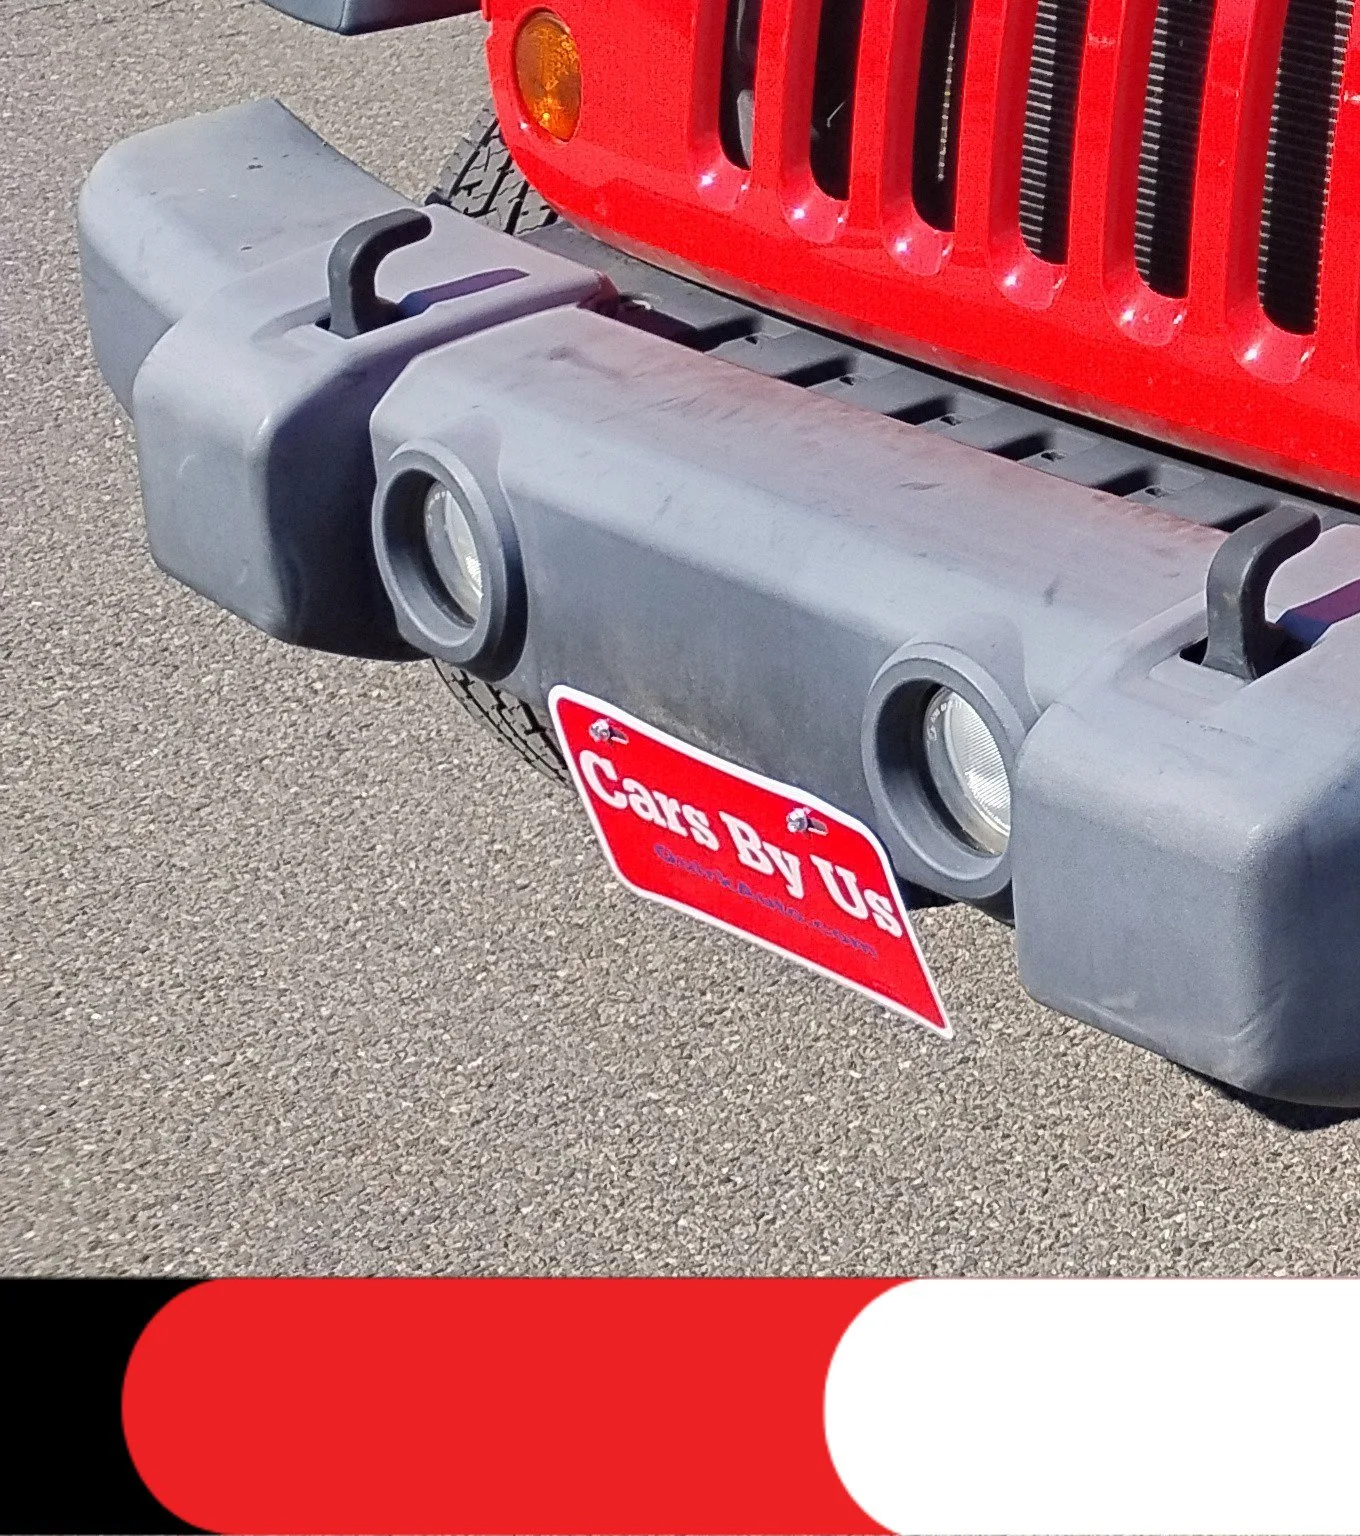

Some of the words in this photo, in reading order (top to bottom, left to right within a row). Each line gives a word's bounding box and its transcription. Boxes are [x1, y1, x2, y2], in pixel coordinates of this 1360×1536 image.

[579, 749, 720, 852] Cars
[718, 810, 805, 900] By
[809, 853, 904, 939] Us
